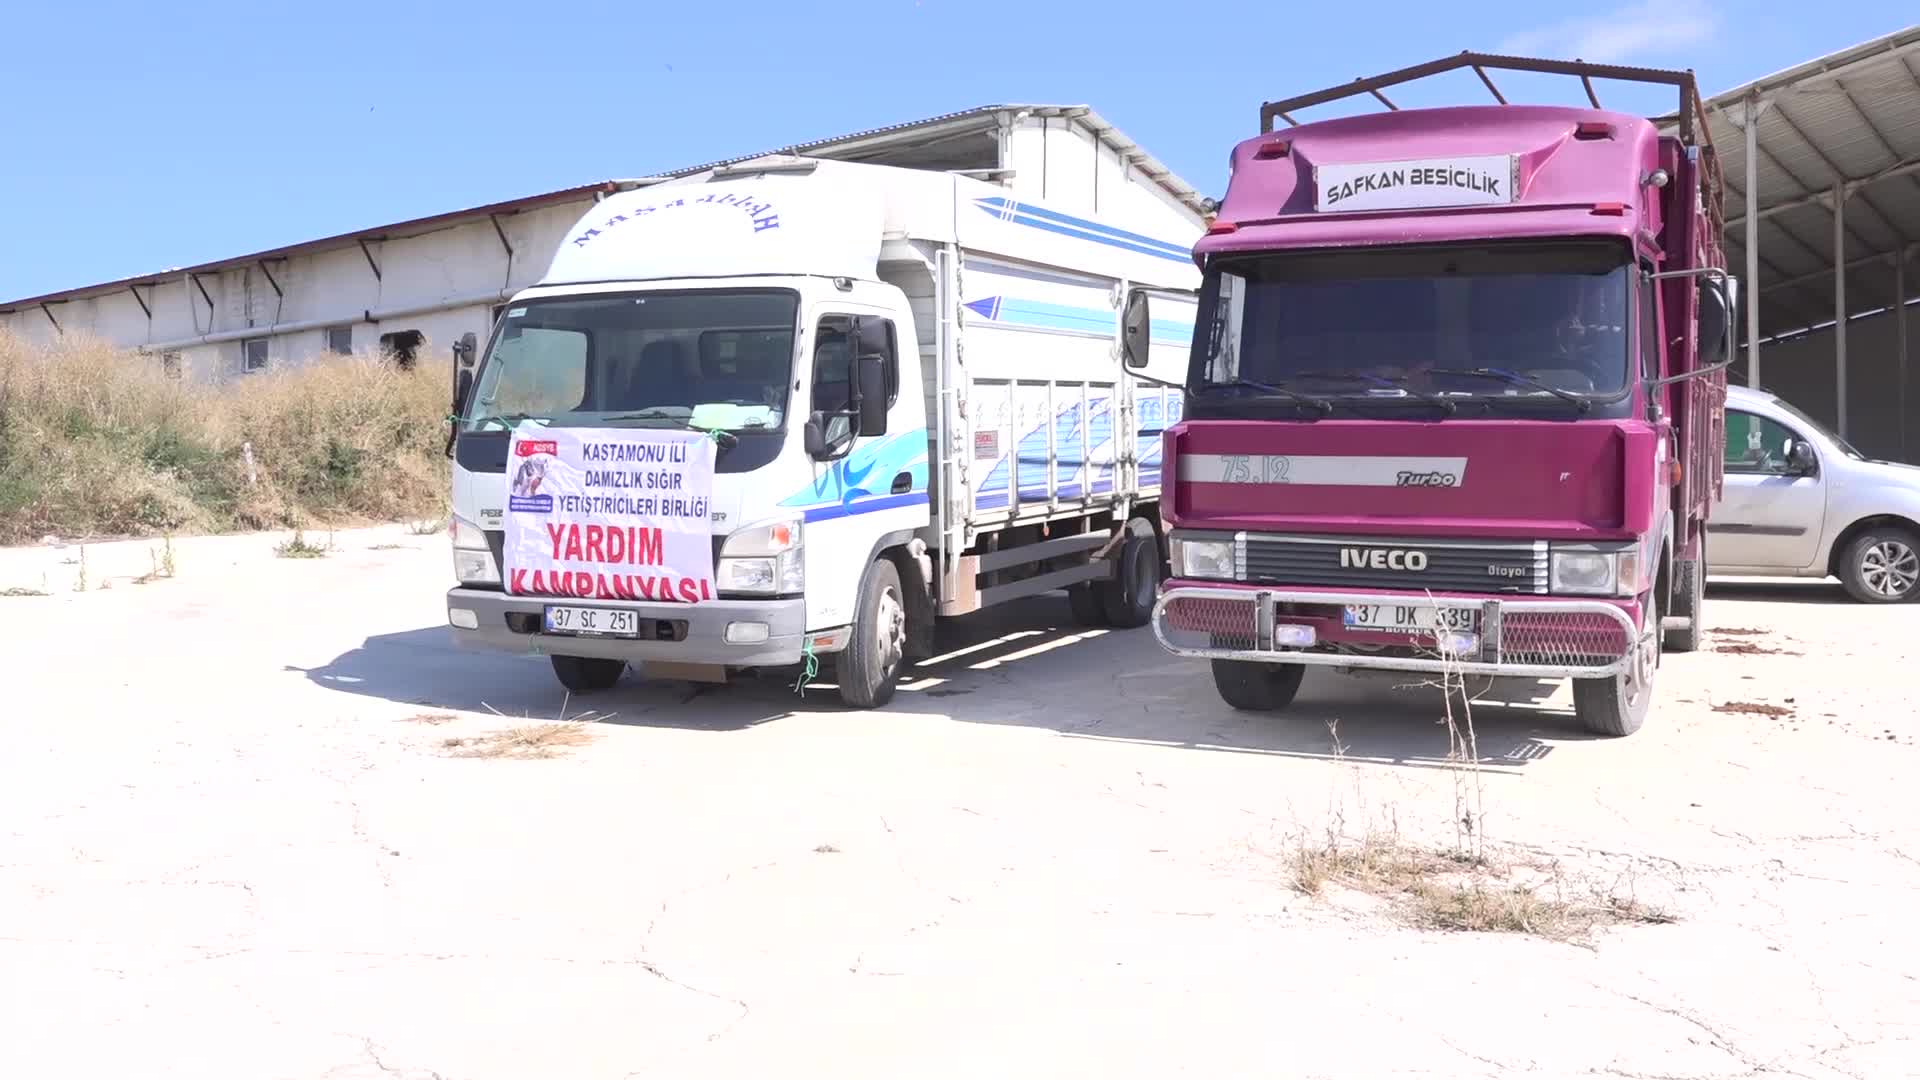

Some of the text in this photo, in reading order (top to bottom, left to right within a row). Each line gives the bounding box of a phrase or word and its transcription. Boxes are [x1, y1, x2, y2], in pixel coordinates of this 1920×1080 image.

[1327, 164, 1500, 205] SAFKAN BESİCİLİK
[583, 440, 686, 463] KASTAMONU İLİ
[585, 468, 682, 489] DAMIZLIK SIĞIR
[1220, 455, 1457, 488] 75.12 Turbo
[558, 492, 658, 517] YETİŞTİRİCİLERİ
[661, 495, 708, 518] BİRLİĞİ
[546, 522, 664, 566] YARDIM
[1340, 547, 1428, 571] IVECO
[510, 567, 711, 604] KAMPANYASI
[556, 608, 634, 631] 37 SC 251
[1358, 605, 1381, 625] 37
[1395, 606, 1417, 626] DK
